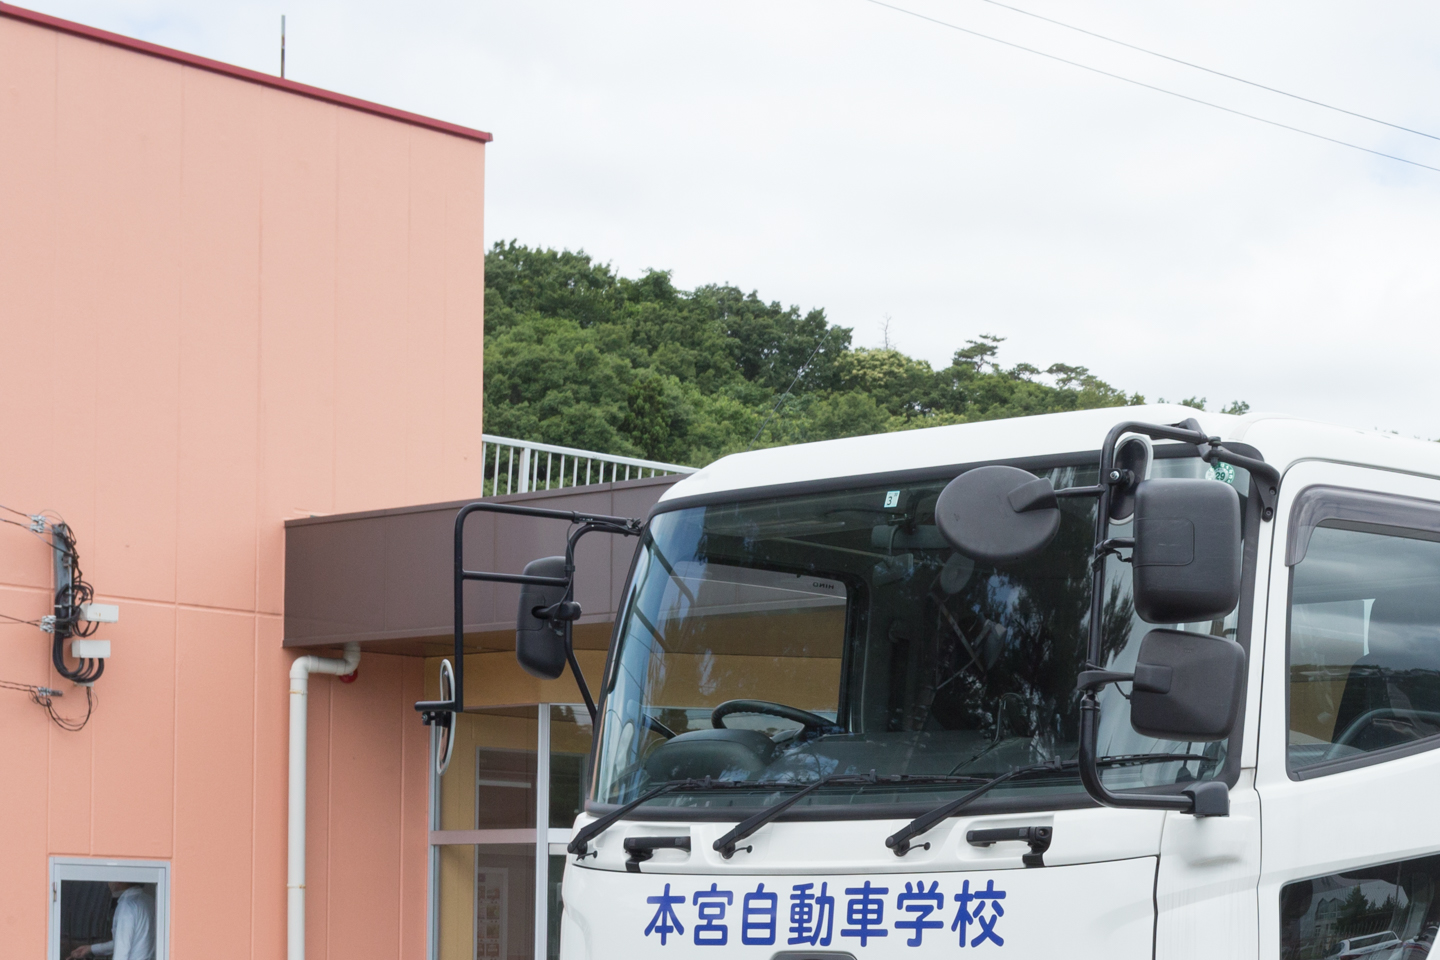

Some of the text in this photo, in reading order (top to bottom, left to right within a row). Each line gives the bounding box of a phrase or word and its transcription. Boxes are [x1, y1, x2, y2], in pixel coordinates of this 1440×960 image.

[644, 880, 1006, 948] 本宮自動車学校
